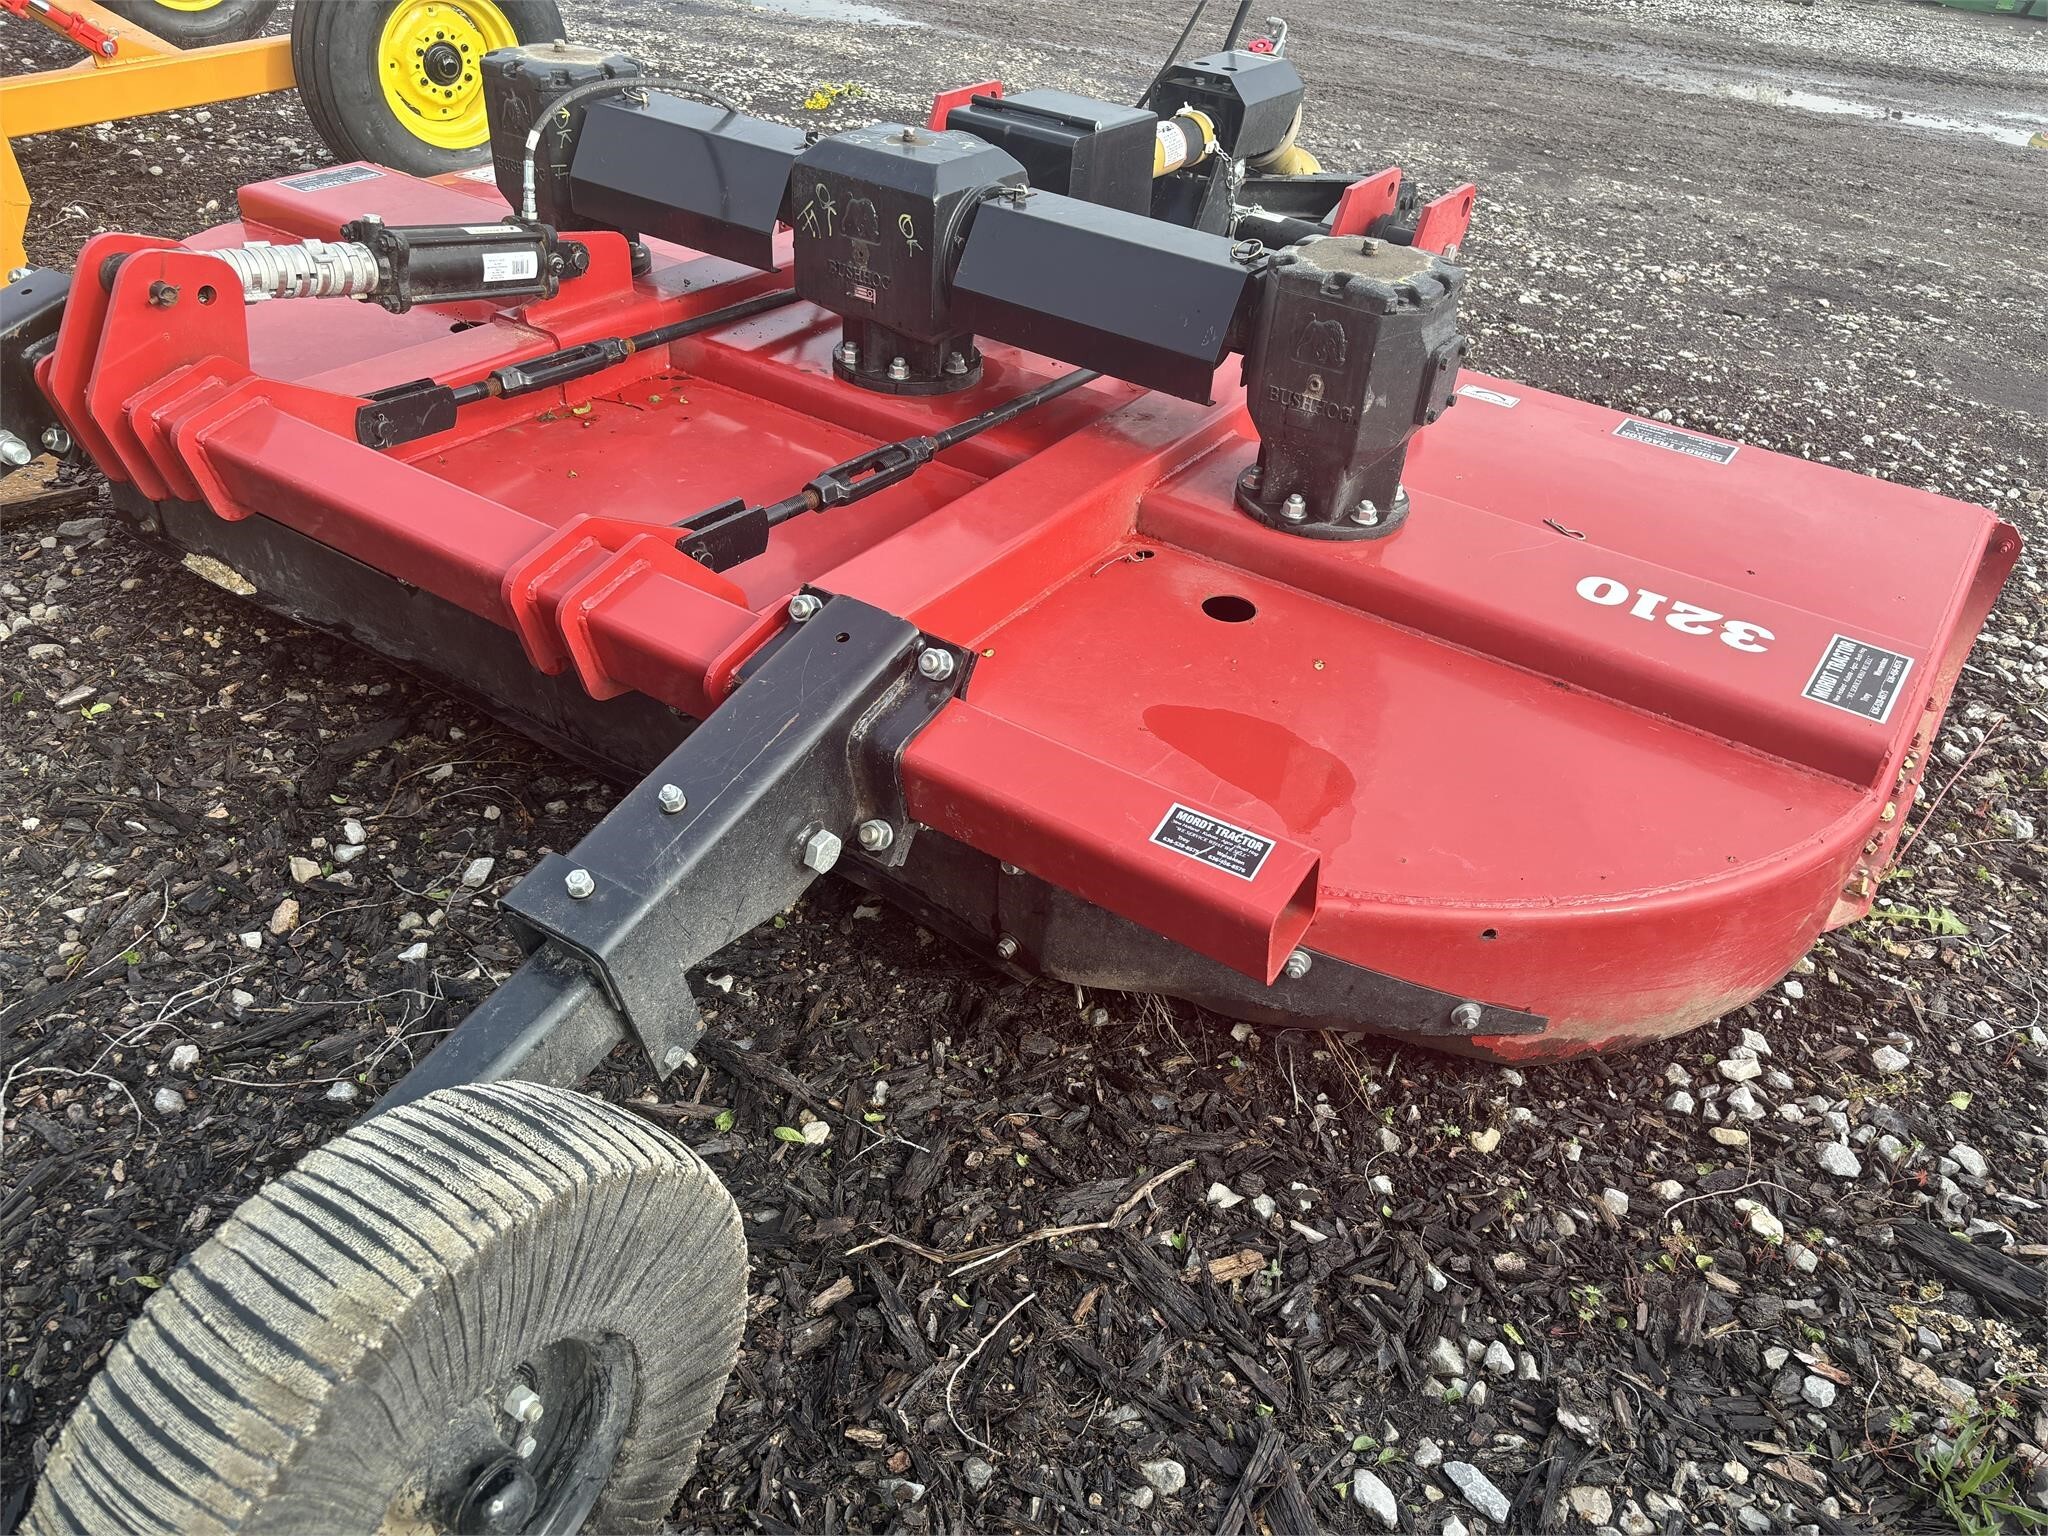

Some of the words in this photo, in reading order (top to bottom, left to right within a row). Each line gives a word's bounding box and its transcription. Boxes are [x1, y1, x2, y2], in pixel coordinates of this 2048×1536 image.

[898, 213, 924, 257] OK
[1575, 576, 1776, 653] 3210
[1811, 670, 1839, 699] MORDT
[1825, 640, 1857, 673] TRACTOR
[1176, 811, 1215, 831] MORDT
[1215, 826, 1264, 851] TRACTOR
